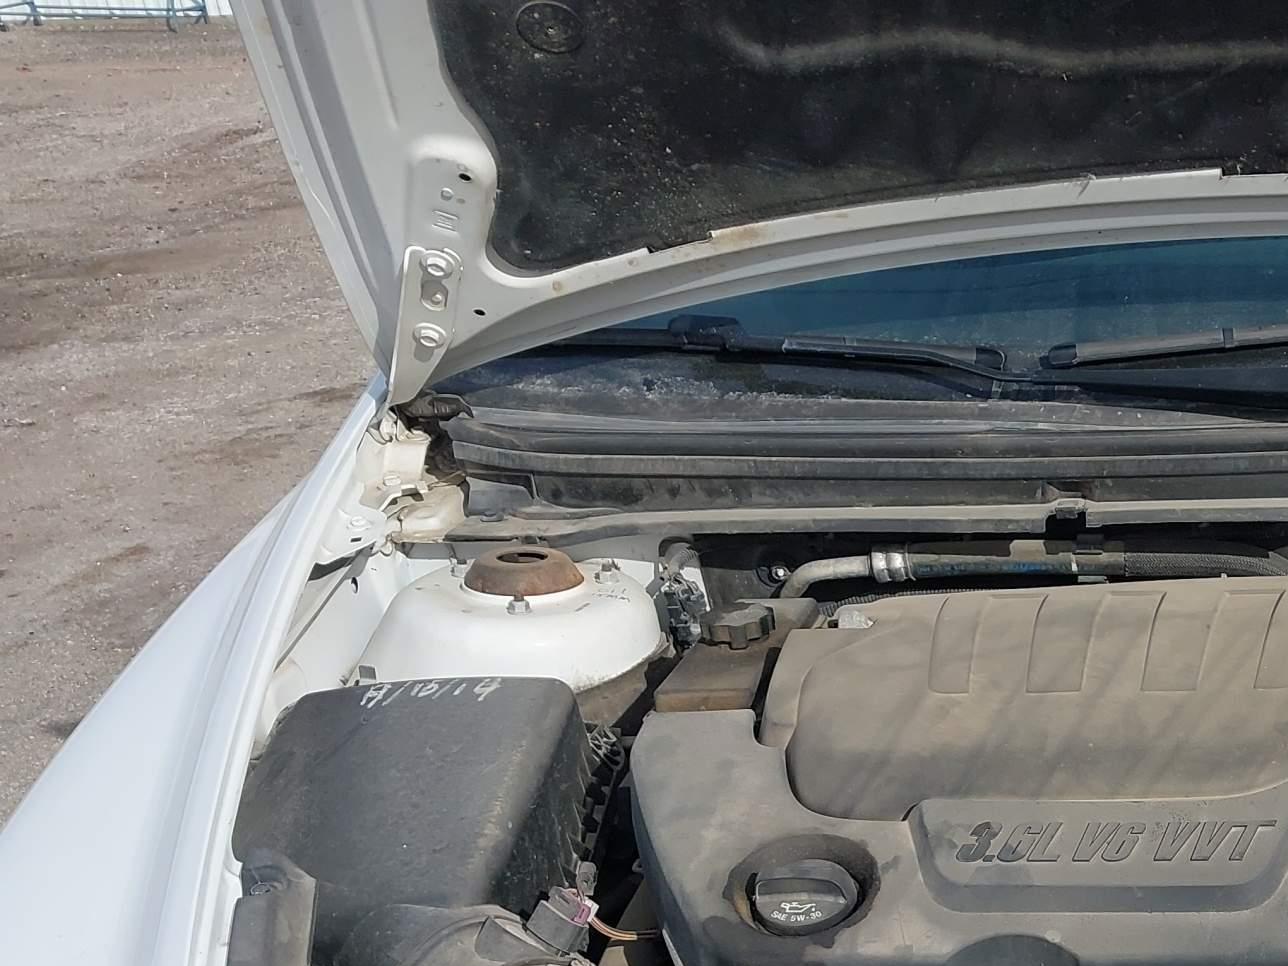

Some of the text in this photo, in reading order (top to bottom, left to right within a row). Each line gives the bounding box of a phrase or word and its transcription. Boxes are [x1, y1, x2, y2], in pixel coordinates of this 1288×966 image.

[956, 818, 1278, 864] 3.6L V6 VVT
[770, 910, 823, 922] SAE 5W-30
